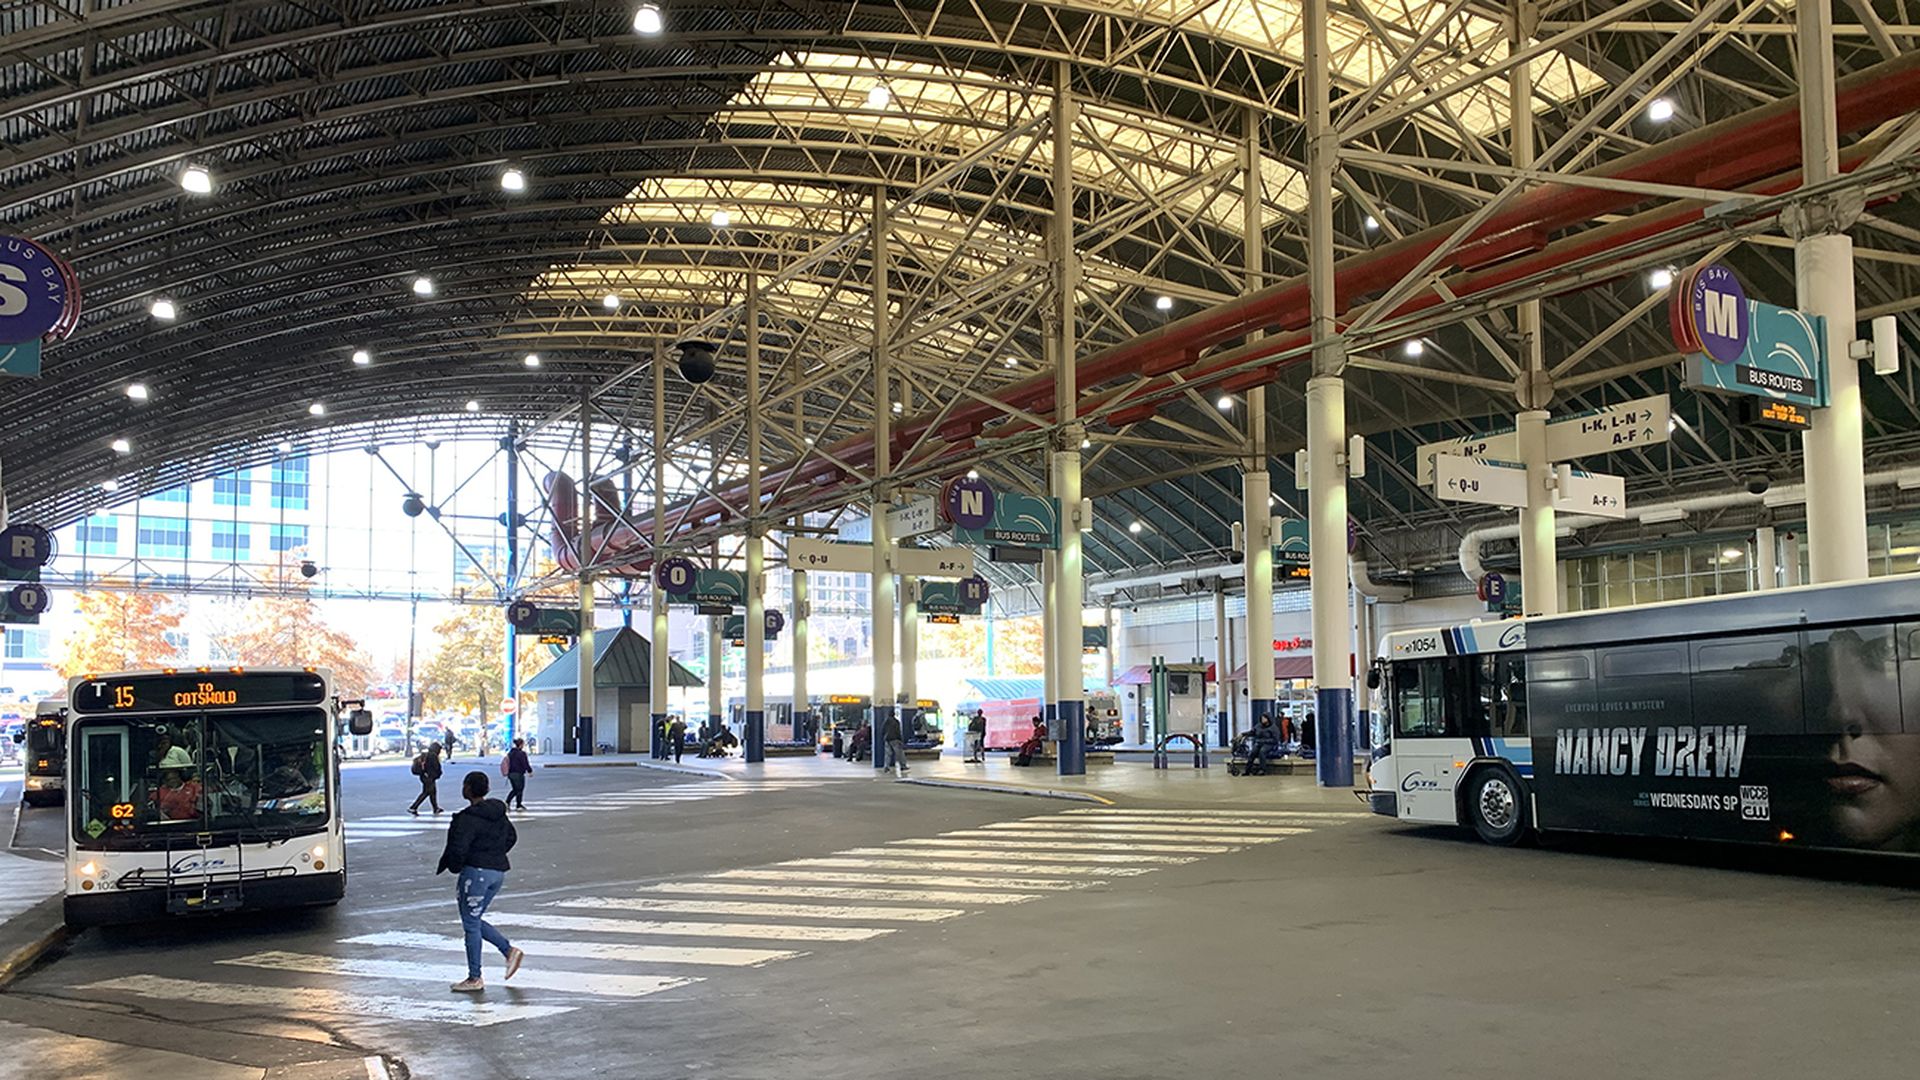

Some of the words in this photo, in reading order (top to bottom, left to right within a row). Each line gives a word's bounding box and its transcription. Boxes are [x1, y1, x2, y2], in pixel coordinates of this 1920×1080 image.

[41, 266, 60, 304] BAY
[1695, 279, 1706, 311] BUS
[1708, 269, 1728, 280] BAY
[1704, 289, 1738, 339] M
[1749, 369, 1767, 385] BUS
[1768, 373, 1803, 392] ROUTES
[1582, 418, 1607, 433] I-K,
[1612, 412, 1636, 428] L-N
[1612, 430, 1637, 445] A-F
[1464, 443, 1487, 457] N-P
[1460, 479, 1479, 492] Q-U
[961, 490, 983, 516] N
[1593, 495, 1608, 506] A-F
[995, 531, 1011, 540] BUS
[1012, 532, 1041, 542] ROUTES
[12, 536, 35, 557] R
[809, 554, 828, 564] Q-U
[939, 562, 955, 570] A-F
[670, 566, 687, 585] O
[968, 583, 980, 598] H
[1490, 580, 1500, 596] E
[20, 590, 37, 610] Q
[517, 607, 530, 621] P
[766, 615, 776, 628] G
[1412, 637, 1436, 652] 1054
[91, 682, 107, 697] T
[198, 683, 214, 692] TO
[114, 685, 135, 708] 15
[174, 691, 236, 706] COTSWOLD
[1601, 702, 1624, 712] LOVES
[1625, 702, 1631, 711] A
[1632, 701, 1665, 710] MYSTERY
[1554, 727, 1648, 776] NANCY
[1655, 725, 1748, 778] DREW
[1650, 793, 1721, 811] WEDNESDAYS
[1722, 795, 1738, 811] 9P
[112, 804, 134, 818] 62
